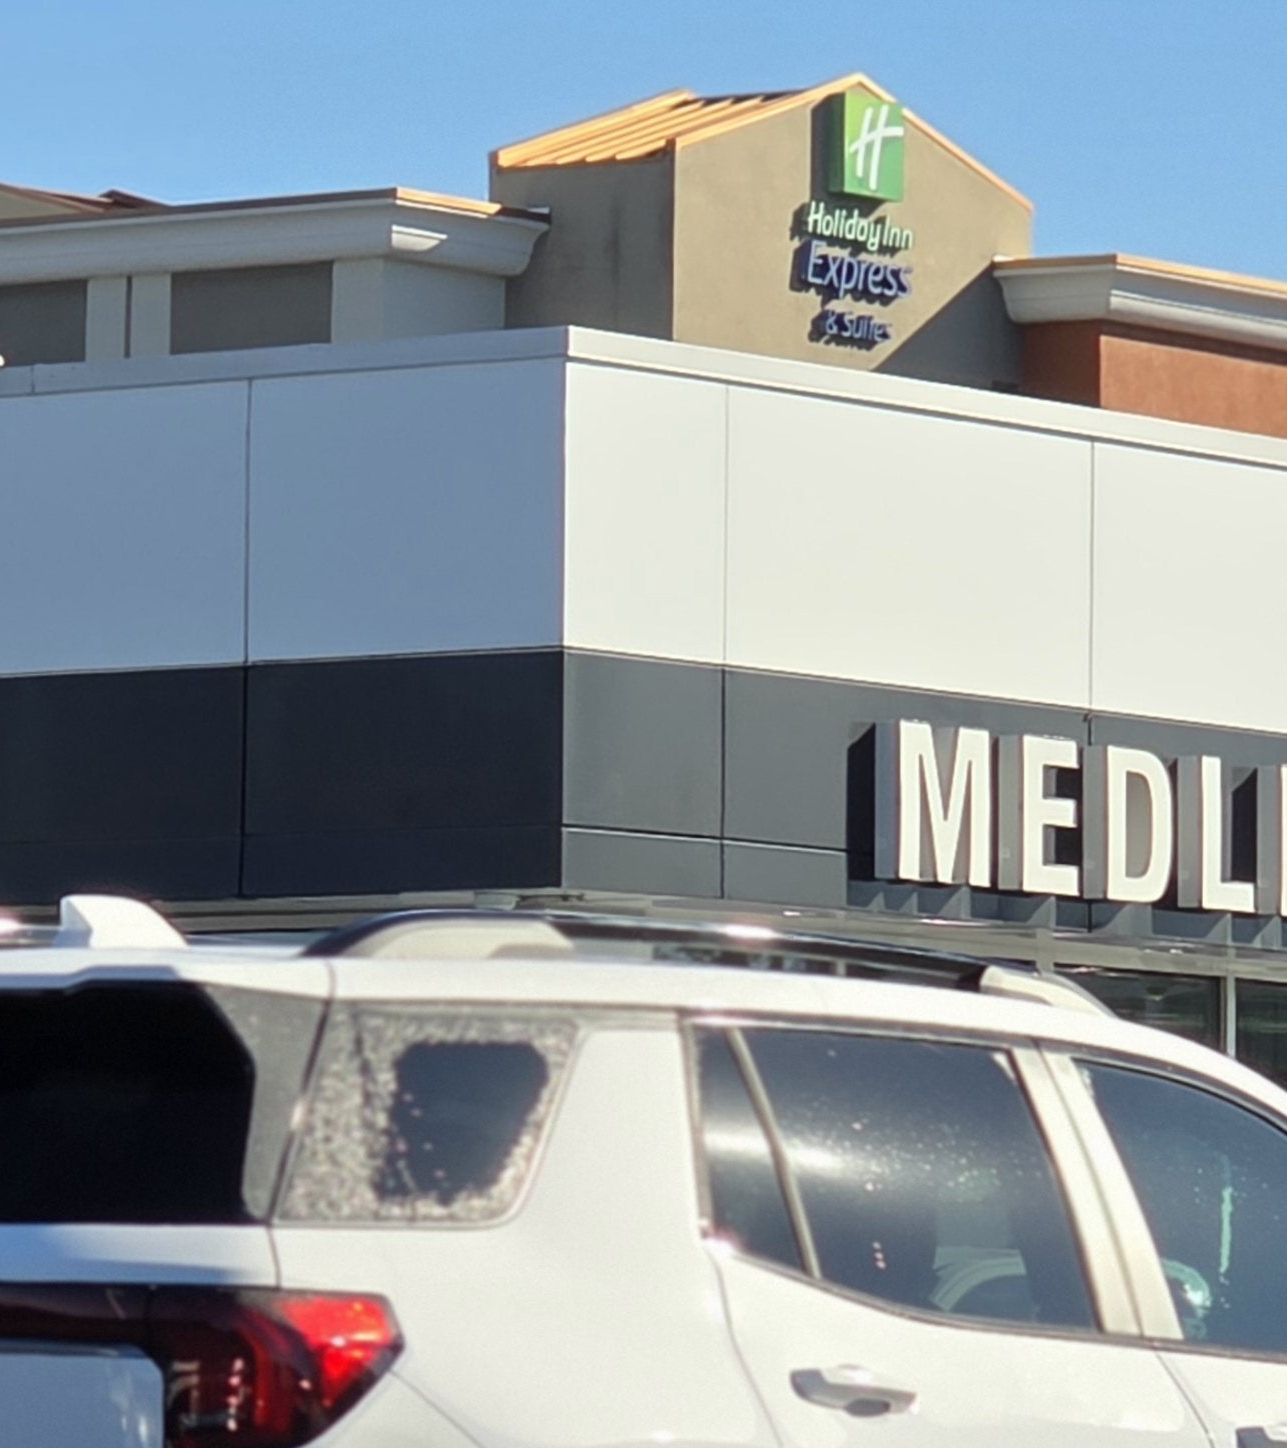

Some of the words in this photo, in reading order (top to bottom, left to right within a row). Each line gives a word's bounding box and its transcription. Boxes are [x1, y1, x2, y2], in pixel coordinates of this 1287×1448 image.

[808, 201, 882, 250] Holiday
[882, 217, 913, 248] Inn
[806, 240, 911, 298] Express
